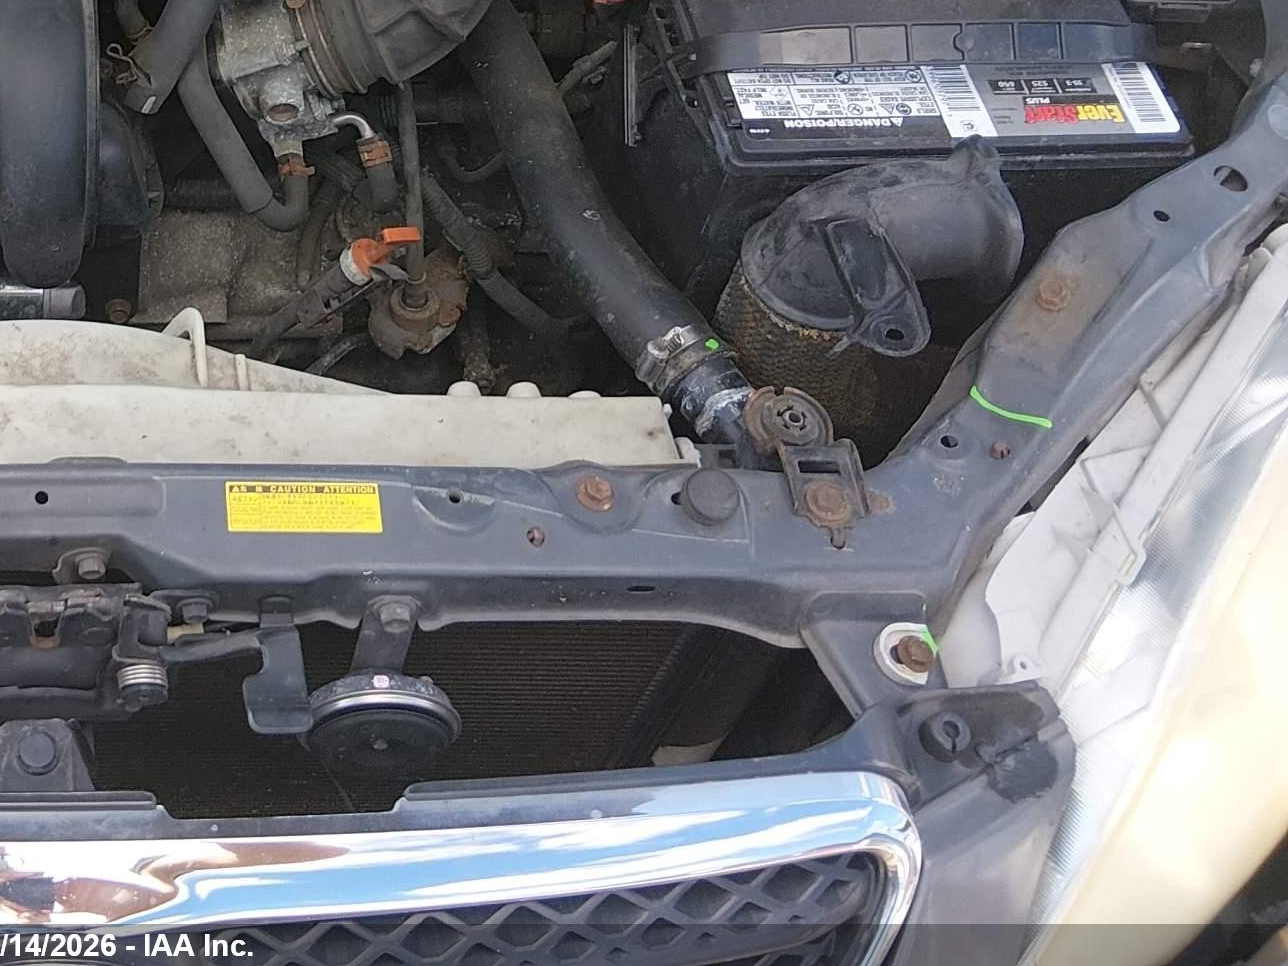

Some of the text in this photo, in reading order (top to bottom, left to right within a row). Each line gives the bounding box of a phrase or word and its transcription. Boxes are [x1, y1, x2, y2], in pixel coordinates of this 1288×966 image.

[1025, 104, 1124, 124] EverStart
[785, 118, 890, 127] DANGER/POISON
[270, 485, 316, 493] CAUTION
[323, 485, 373, 494] ATTENTION
